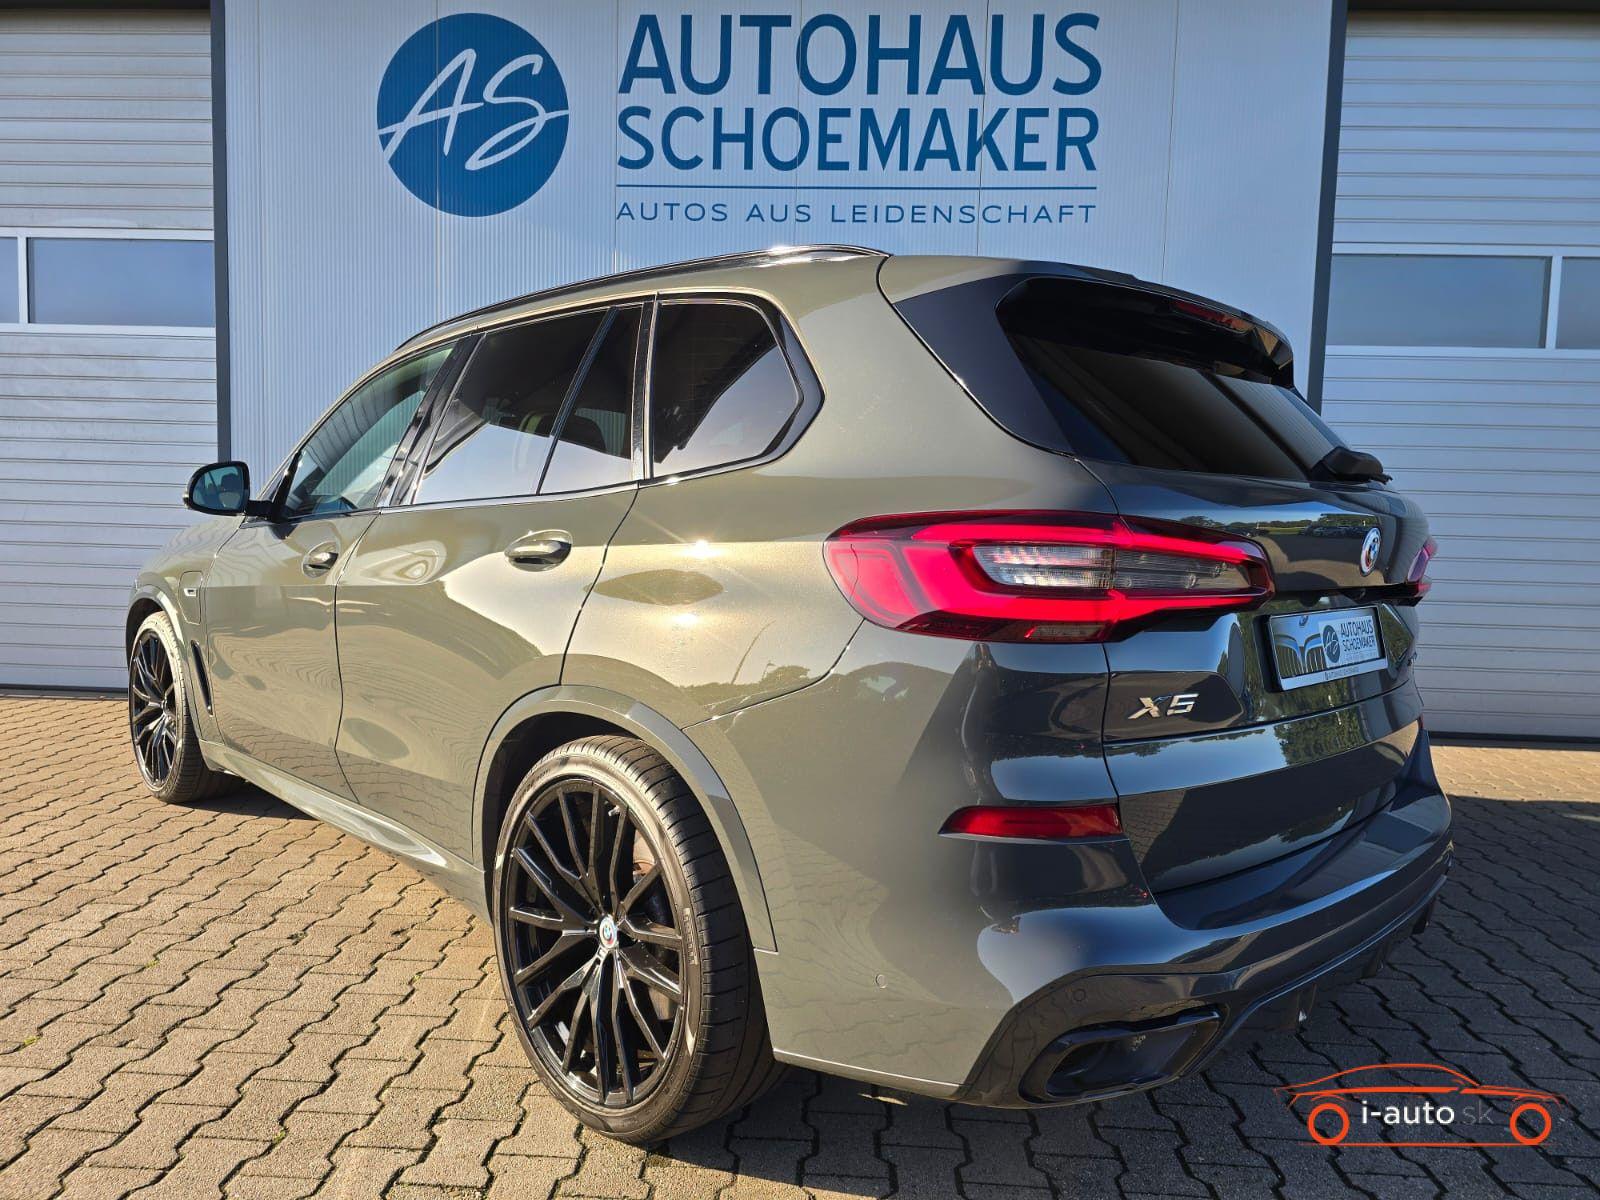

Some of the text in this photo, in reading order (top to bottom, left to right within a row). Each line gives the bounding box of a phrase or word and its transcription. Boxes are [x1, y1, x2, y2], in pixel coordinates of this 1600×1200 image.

[619, 12, 1102, 96] AUTOHAUS
[377, 48, 569, 171] AS
[616, 106, 1099, 172] SCHOEMAKER
[616, 202, 1097, 224] AUTOS AUS LEIDENSCHAFT
[1340, 620, 1374, 637] AUTOHAUS
[1342, 636, 1375, 652] SCHOEMAKER
[1127, 693, 1199, 719] X5
